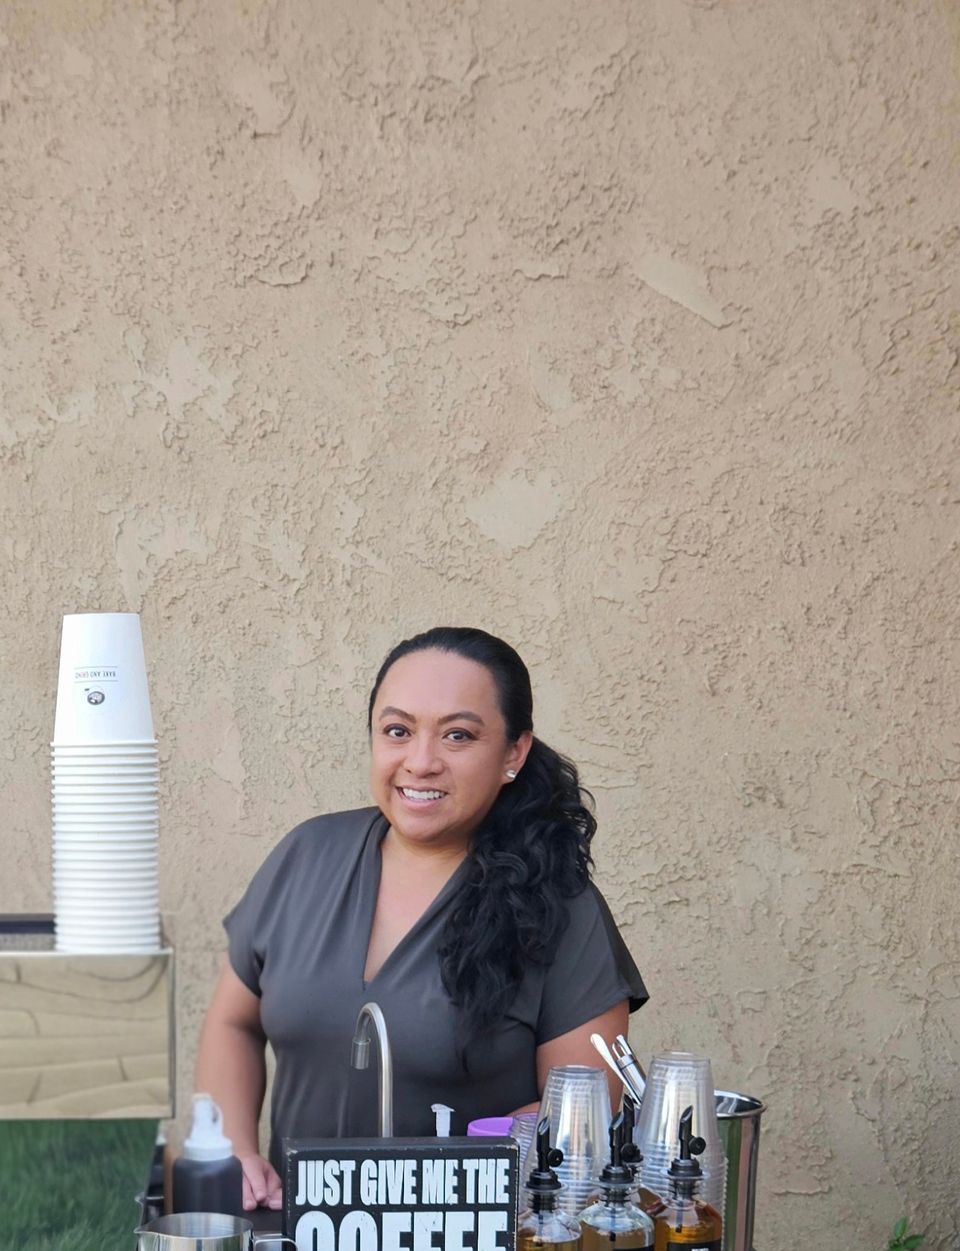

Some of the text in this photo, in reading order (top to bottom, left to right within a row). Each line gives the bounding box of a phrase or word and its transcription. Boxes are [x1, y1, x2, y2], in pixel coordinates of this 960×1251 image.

[295, 1158, 510, 1207] JUST GIVE ME THE
